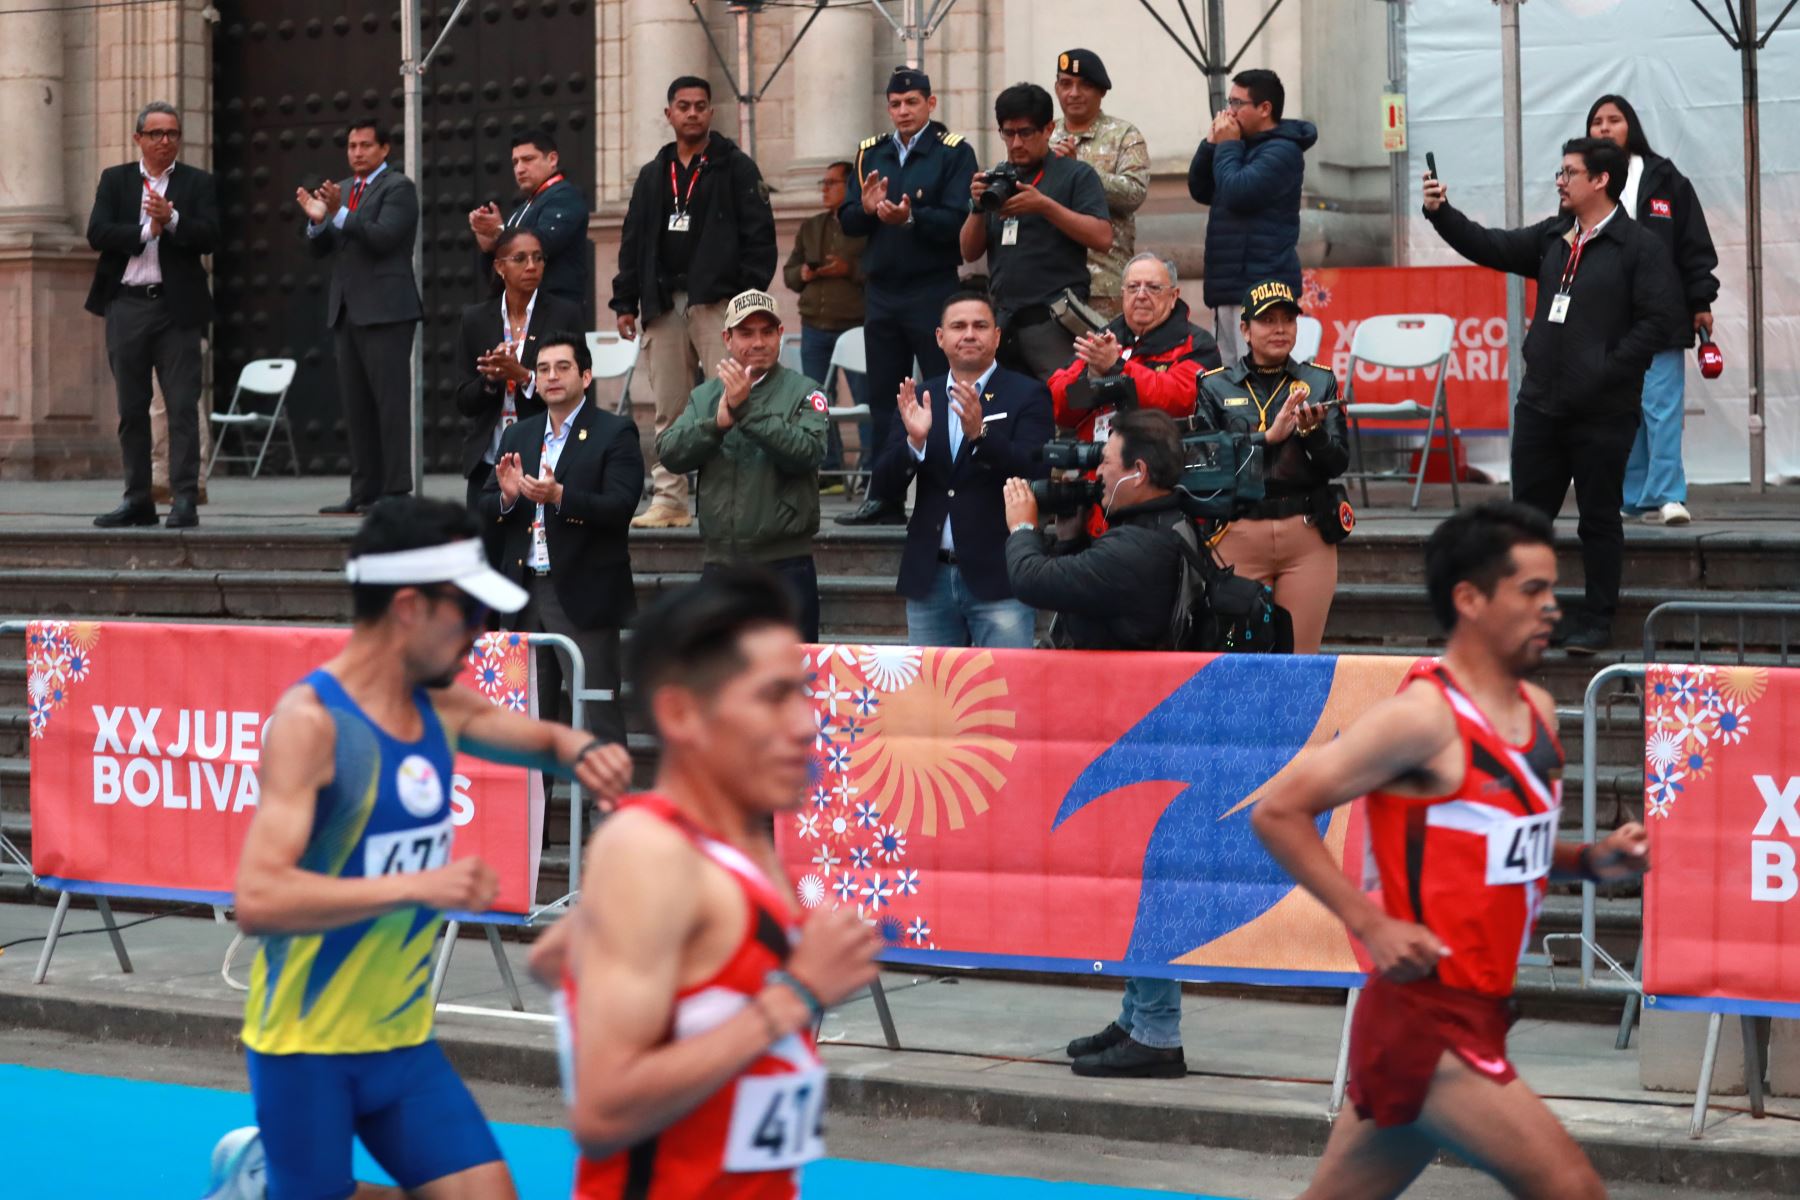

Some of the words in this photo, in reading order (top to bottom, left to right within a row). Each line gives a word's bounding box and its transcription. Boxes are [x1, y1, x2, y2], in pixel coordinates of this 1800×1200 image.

[734, 293, 774, 313] PRESIDENTE
[1250, 282, 1294, 306] POLICIA
[92, 705, 162, 756] XX
[166, 709, 275, 762] JUE
